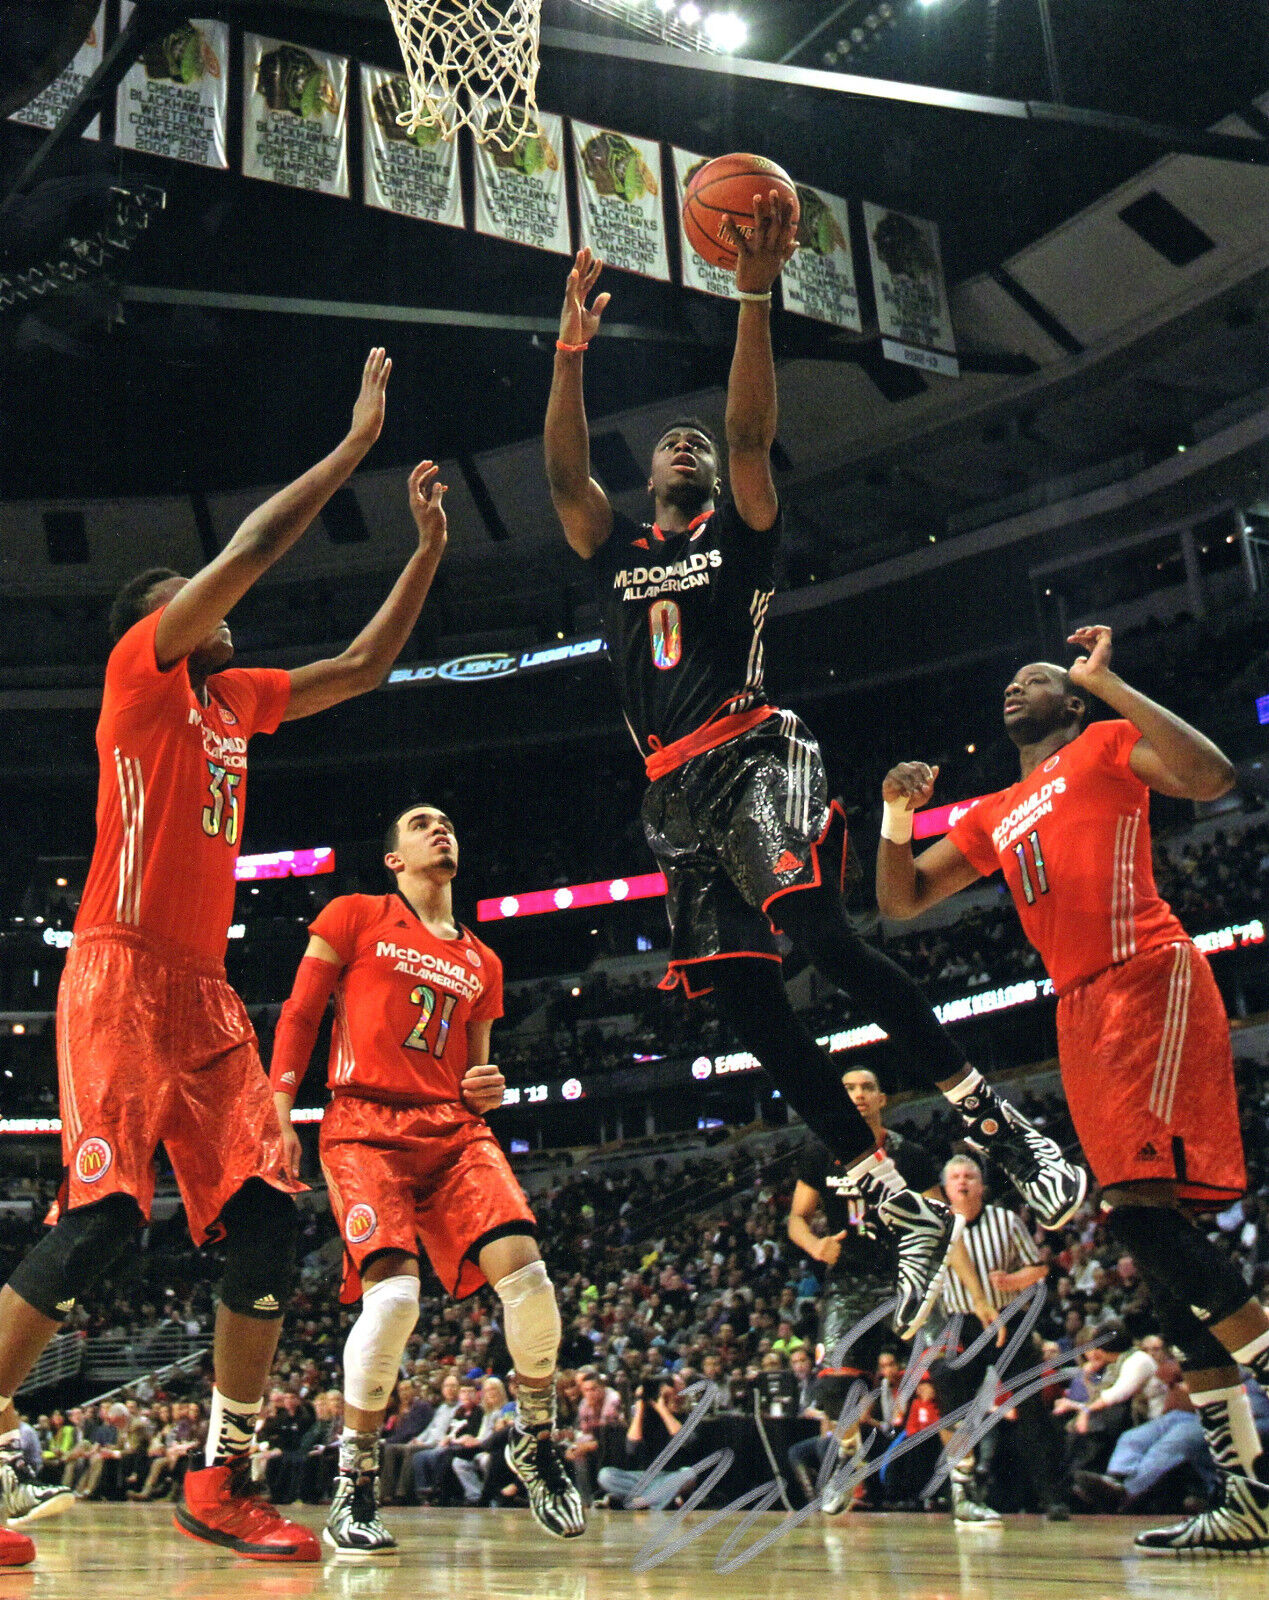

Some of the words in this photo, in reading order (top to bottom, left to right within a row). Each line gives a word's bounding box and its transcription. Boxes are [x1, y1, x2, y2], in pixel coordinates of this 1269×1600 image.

[130, 88, 215, 118] BLACKHAWKS
[147, 81, 200, 104] CHICAGO
[129, 112, 214, 141] CONFERENCE
[141, 103, 204, 126] WESTERN
[135, 125, 209, 151] CHAMPIONS
[256, 120, 338, 146] BLACKHAWKS
[256, 143, 337, 172] CONFERENCE
[263, 155, 332, 181] CHAMPIONS
[375, 148, 450, 177] BLACKHAWKS
[377, 171, 451, 200] CONFERENCE
[498, 169, 544, 190] CHICAGO
[383, 185, 446, 210] CHAMPIONS
[391, 199, 439, 220] 1972-73
[493, 189, 550, 214] CAMPBELL
[599, 196, 643, 217] CHICAGO
[487, 198, 558, 227] CONFERENCE
[493, 211, 554, 238] CHAMPIONS
[588, 202, 658, 231] BLACKHAWKS
[505, 228, 544, 247] 1971-72
[591, 225, 658, 254] CONFERENCE
[594, 216, 650, 242] CAMPBELL
[596, 239, 655, 264] CHAMPIONS
[606, 253, 646, 274] 1970-71
[648, 599, 682, 670] 0
[388, 666, 437, 683] BUD
[450, 656, 516, 676] LIGHT
[520, 638, 602, 668] LEGENDS
[202, 758, 241, 846] 35
[1012, 830, 1049, 905] 11
[401, 984, 458, 1059] 21
